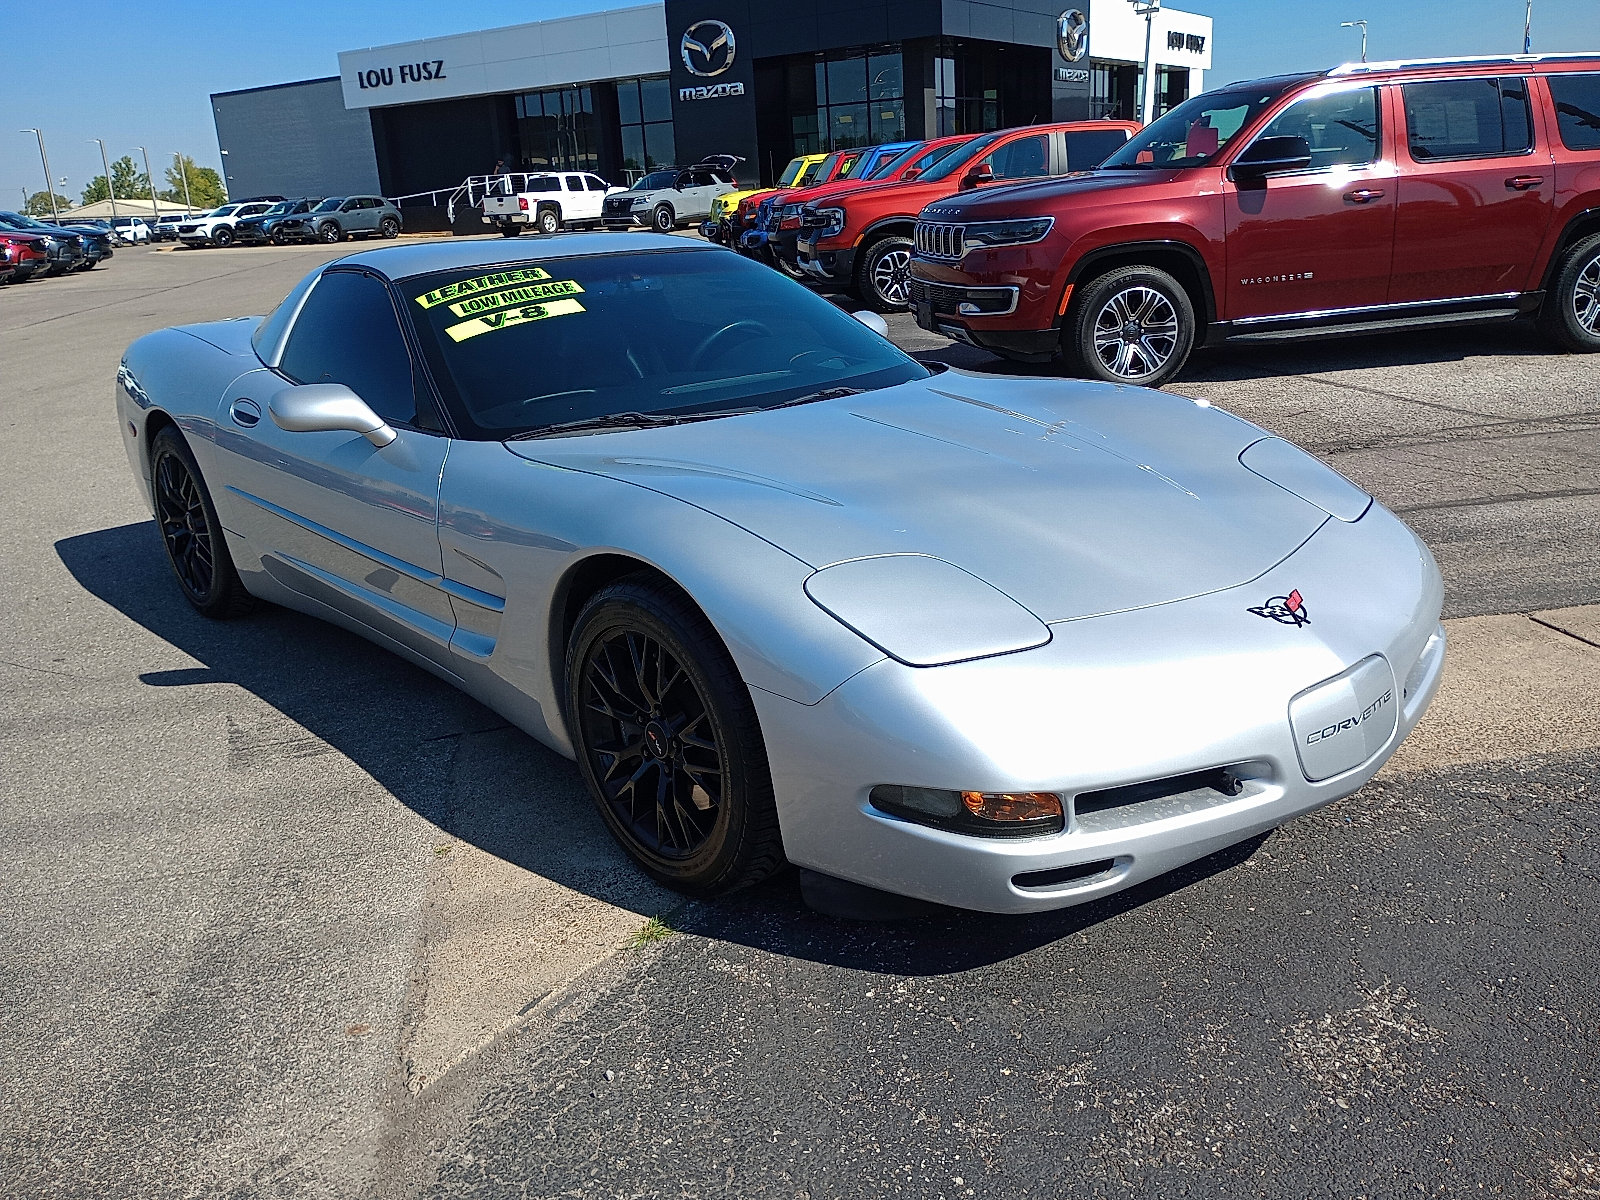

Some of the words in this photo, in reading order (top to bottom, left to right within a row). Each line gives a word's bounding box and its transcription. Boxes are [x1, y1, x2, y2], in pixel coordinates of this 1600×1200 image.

[357, 66, 394, 89] LOU
[399, 60, 447, 84] FUSZ
[679, 82, 745, 101] mazda
[424, 268, 544, 305] LEATHER
[459, 294, 501, 316] LOW
[500, 281, 576, 305] MILEAGE
[479, 305, 549, 329] V-8
[1306, 688, 1393, 746] CORVETTE
